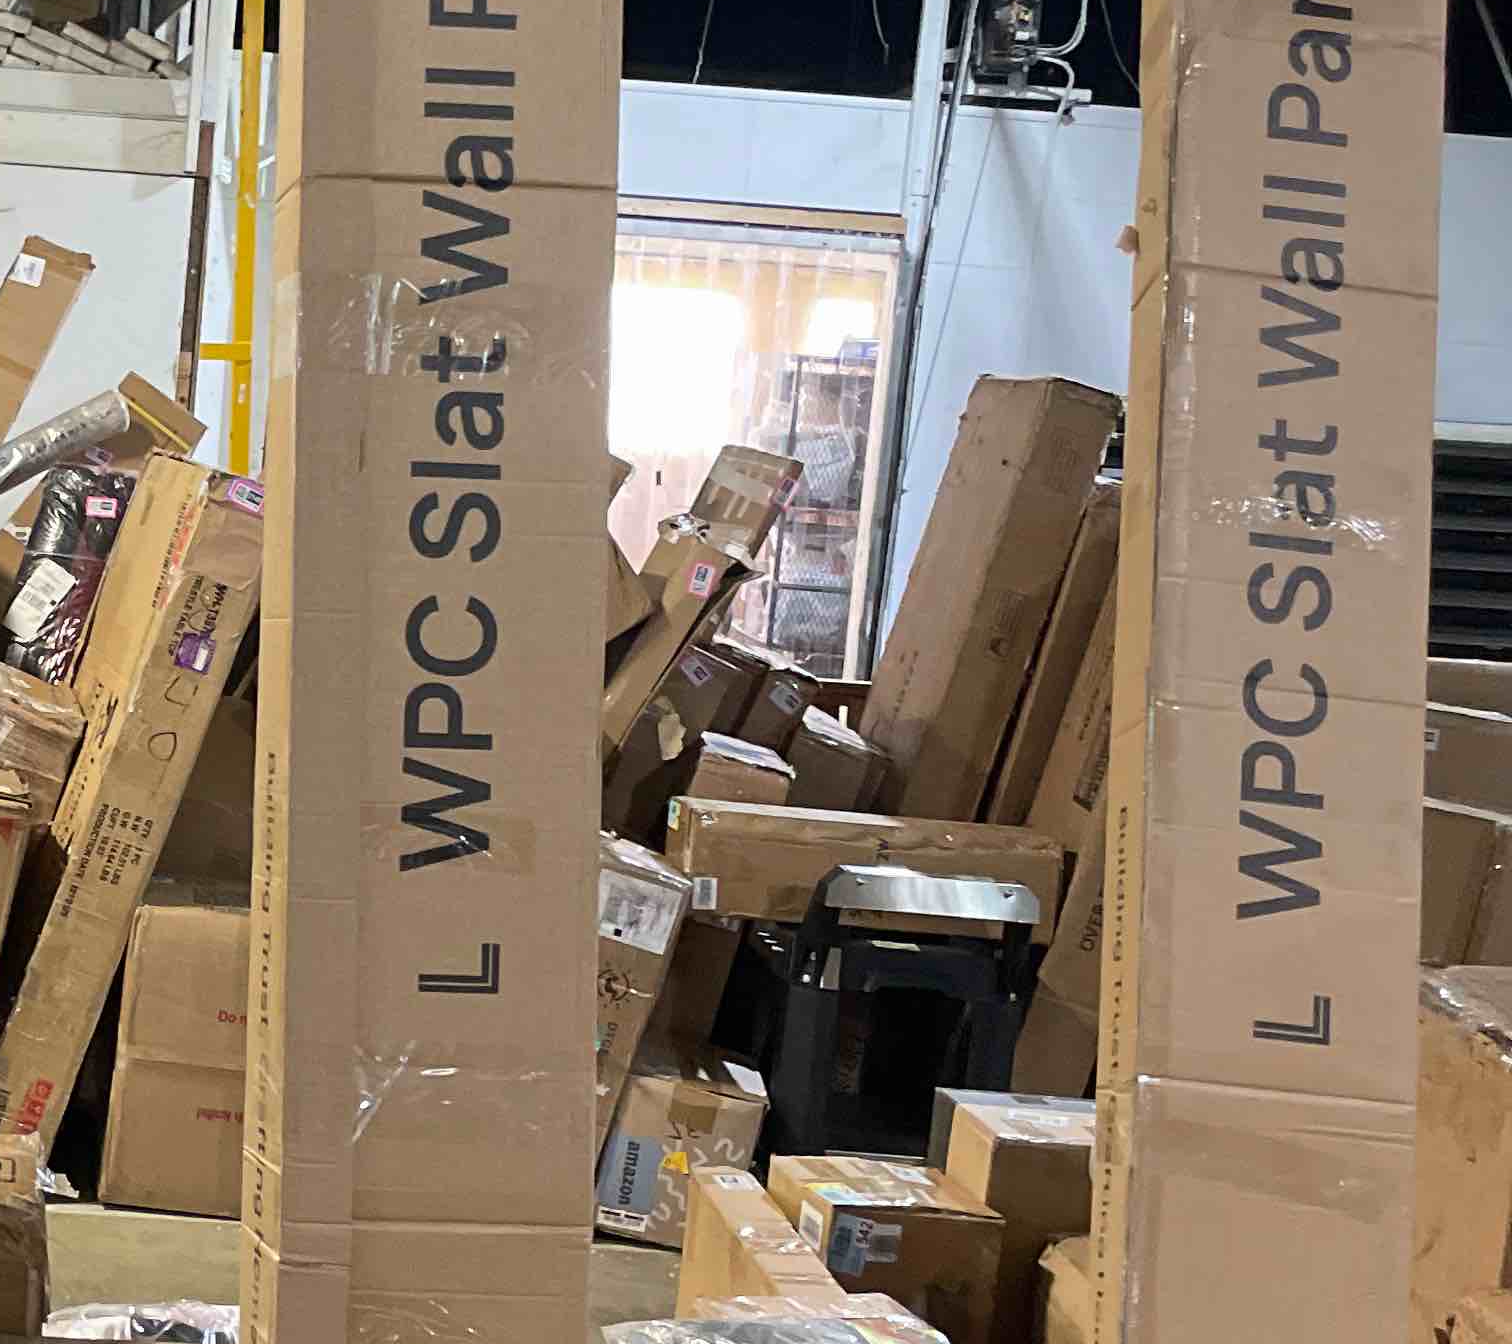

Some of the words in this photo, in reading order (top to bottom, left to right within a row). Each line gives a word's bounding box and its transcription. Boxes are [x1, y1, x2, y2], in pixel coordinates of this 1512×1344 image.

[416, 67, 516, 306] Wall
[1256, 175, 1347, 388] Wall
[408, 335, 507, 563] Slat
[1246, 417, 1339, 631] Slat
[399, 594, 499, 872] WPC
[1235, 657, 1330, 921] WPC
[216, 1009, 238, 1025] Do
[618, 1141, 641, 1206] amazon
